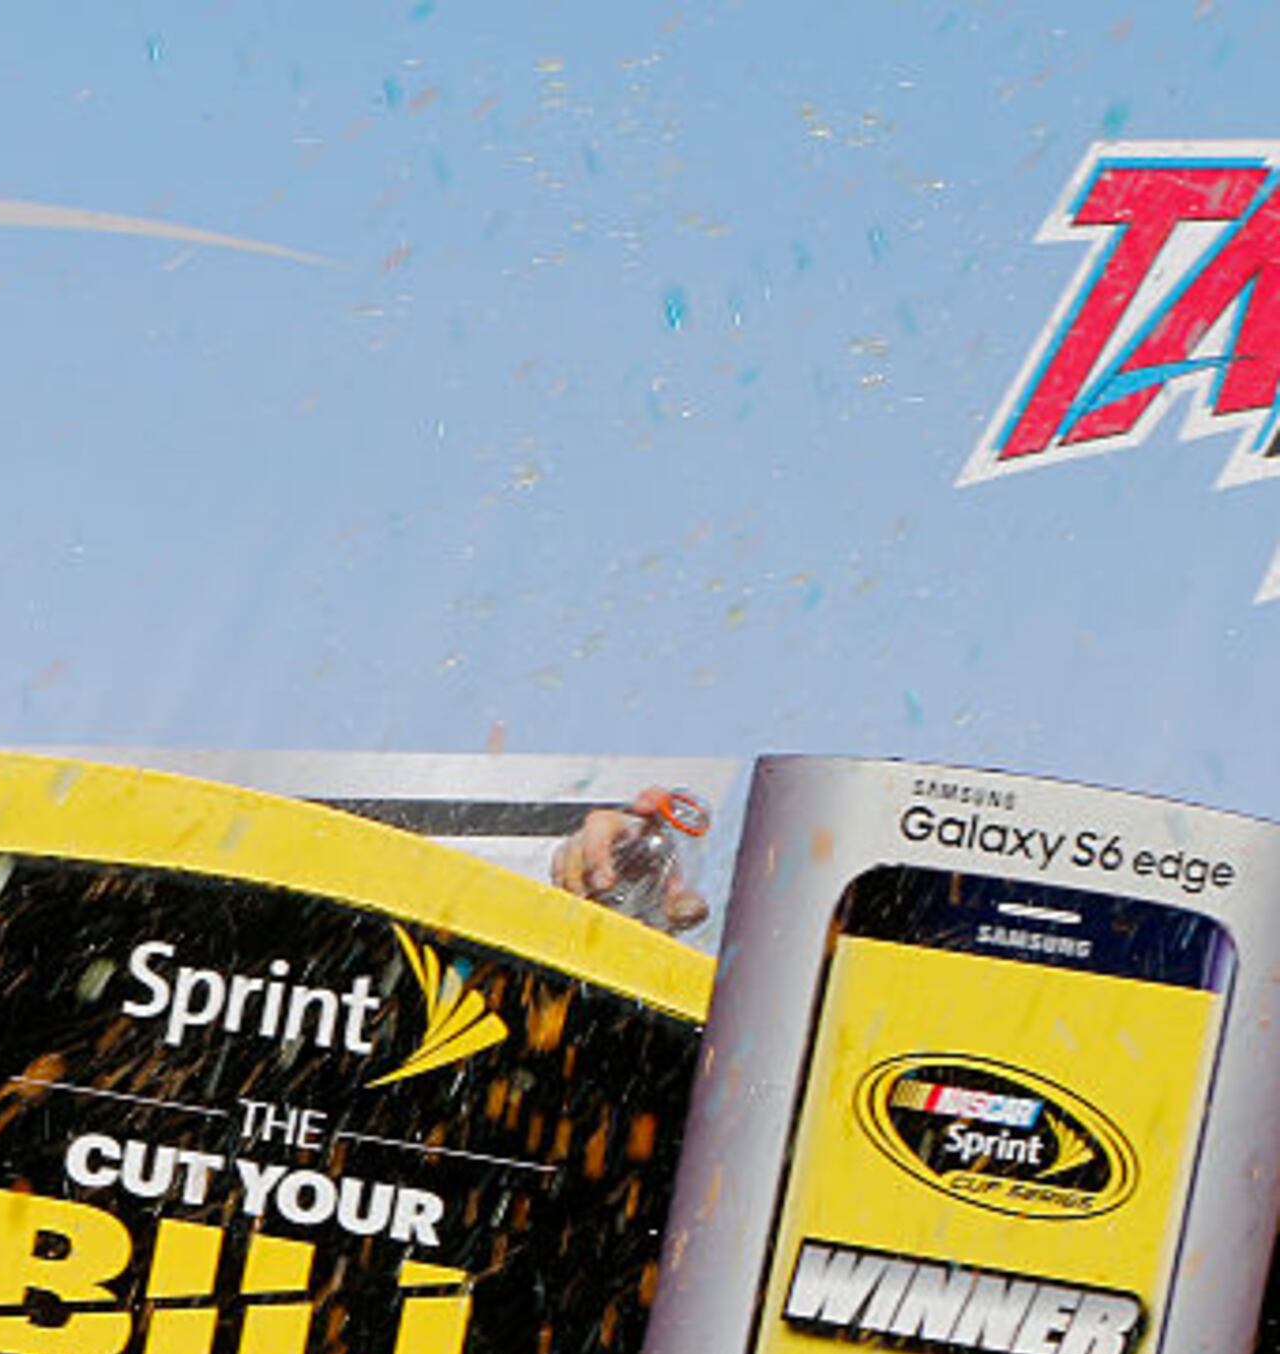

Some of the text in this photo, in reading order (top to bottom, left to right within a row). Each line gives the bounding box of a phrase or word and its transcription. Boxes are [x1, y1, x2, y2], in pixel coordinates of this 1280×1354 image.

[912, 779, 1016, 811] SAMSUNG
[900, 805, 1236, 894] Galaxy S6 edge
[977, 925, 1094, 959] SAMSUNG
[123, 939, 380, 1056] Sprint
[240, 1099, 328, 1151] THE
[944, 1122, 1044, 1165] Sprint
[65, 1133, 445, 1247] CUT YOUR
